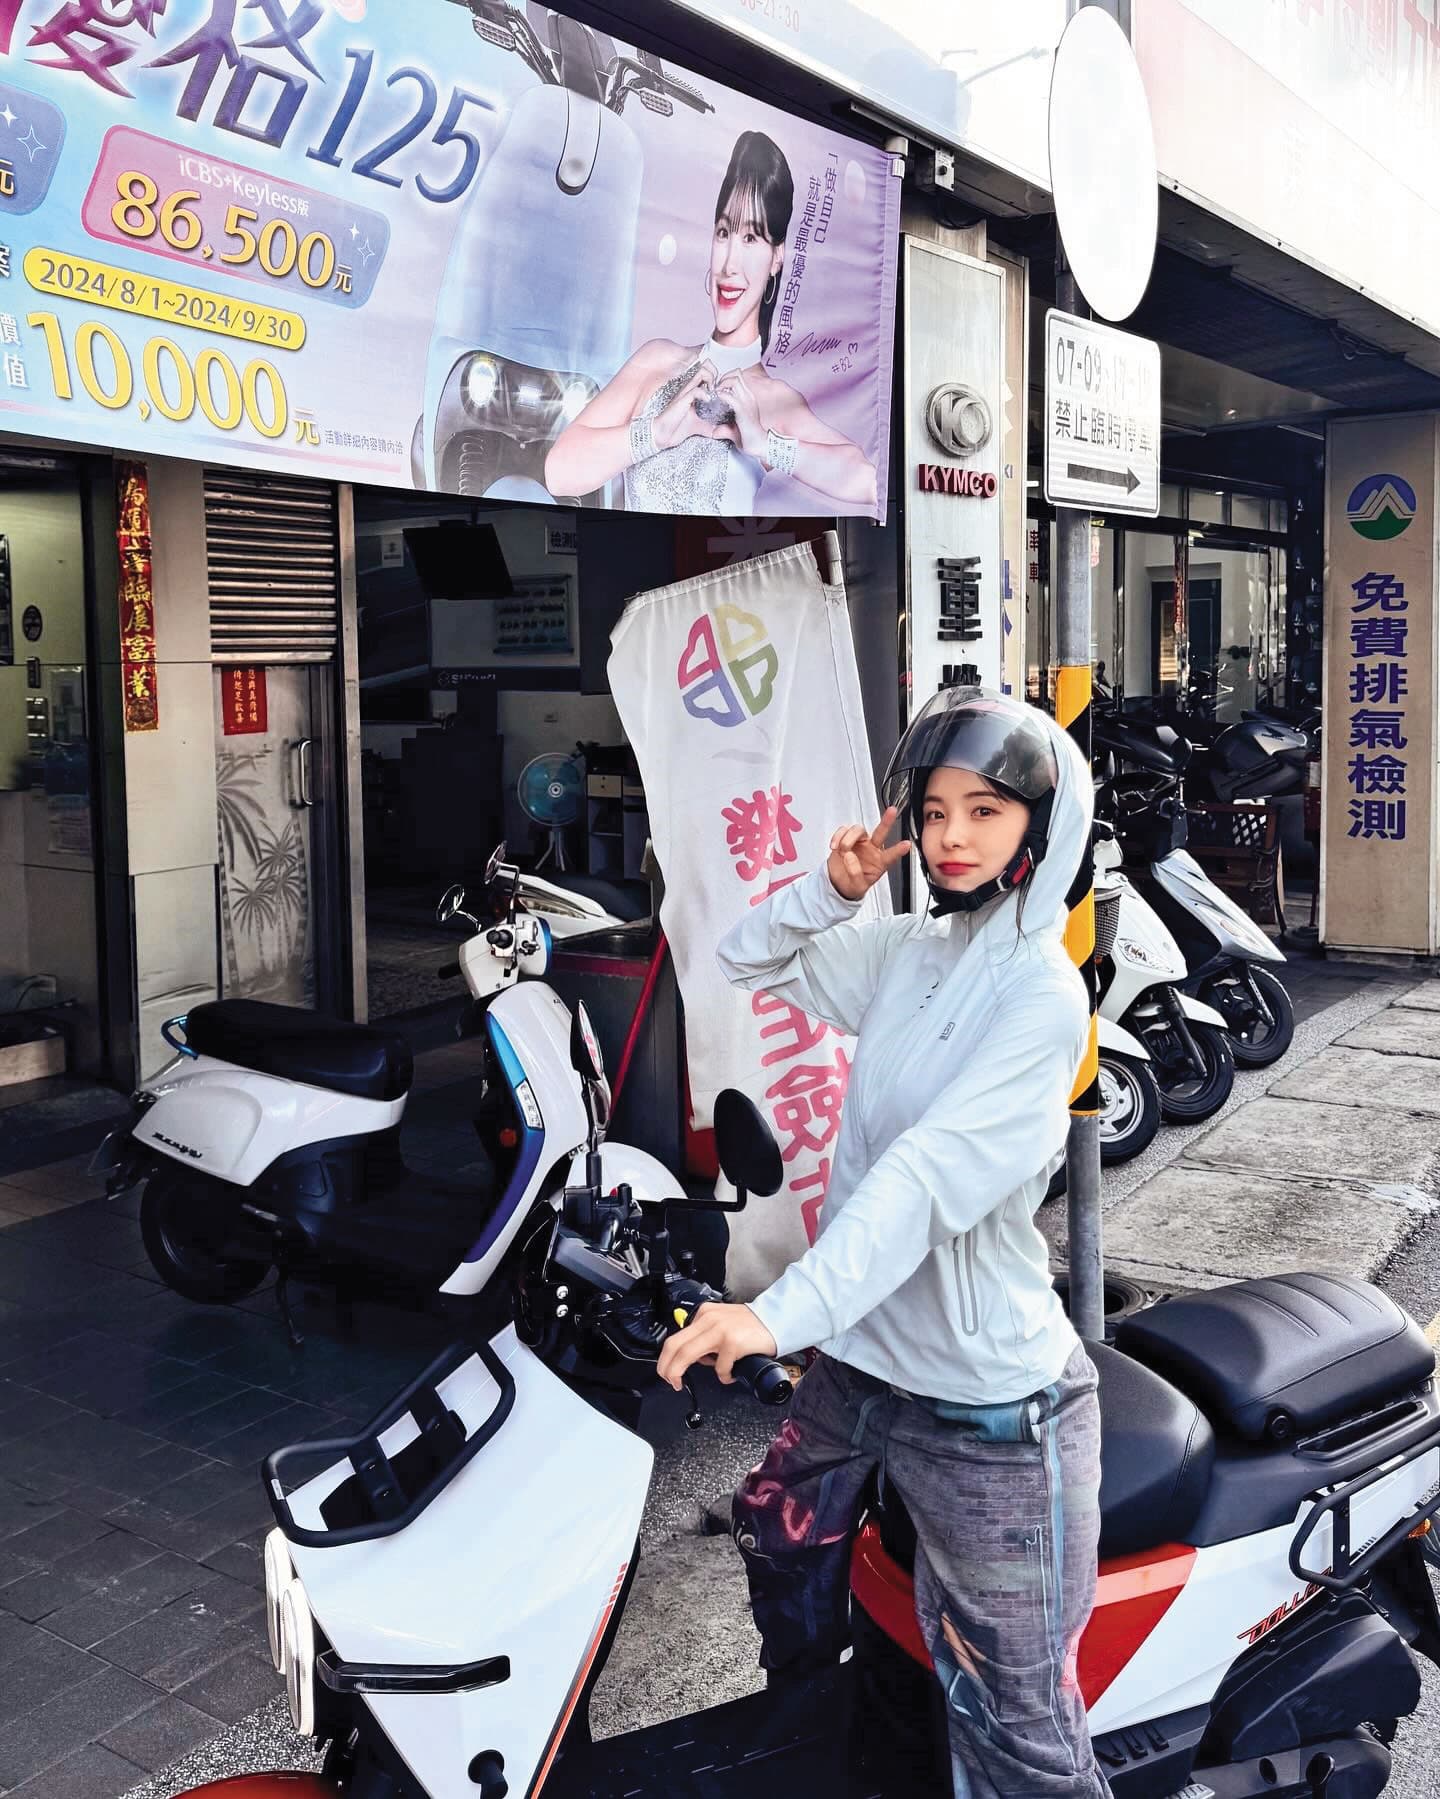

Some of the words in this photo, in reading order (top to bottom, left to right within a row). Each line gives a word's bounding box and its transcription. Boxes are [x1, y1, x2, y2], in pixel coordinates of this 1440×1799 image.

[39, 257, 292, 343] 2024/8/1~2024/9/30
[917, 463, 998, 498] KYMCO
[551, 531, 577, 549] 檢測
[1348, 572, 1409, 841] 免費排氣檢測
